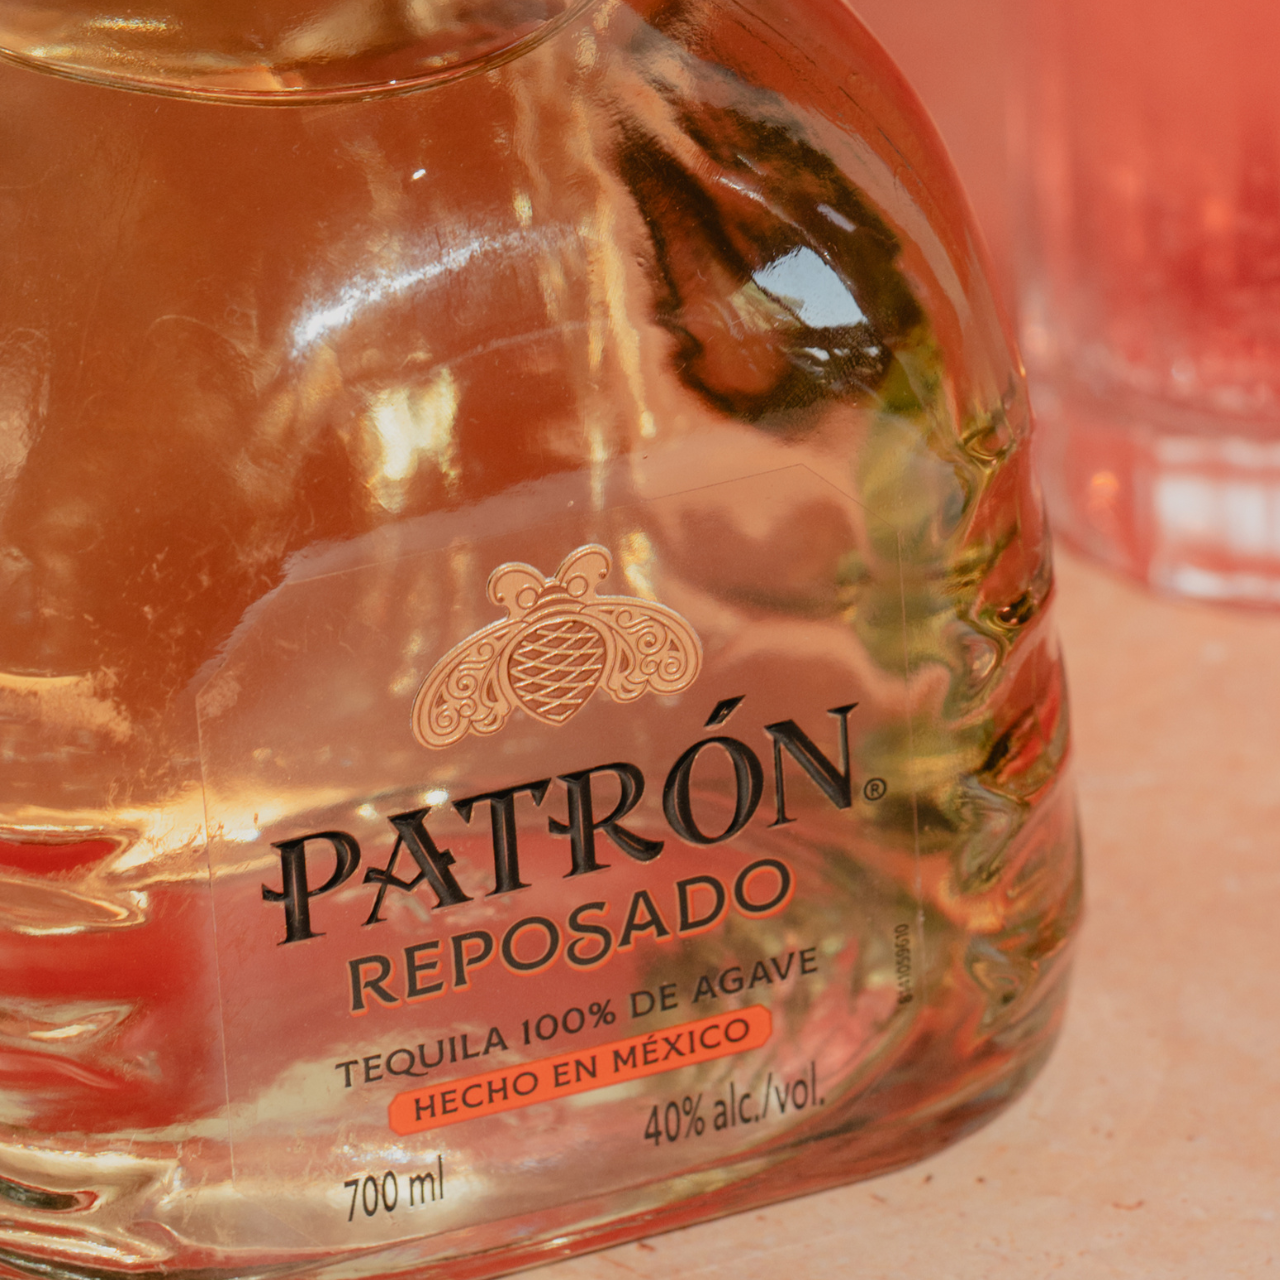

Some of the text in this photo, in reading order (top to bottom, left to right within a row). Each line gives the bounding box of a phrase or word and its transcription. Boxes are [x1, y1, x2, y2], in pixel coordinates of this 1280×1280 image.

[261, 694, 860, 946] PATRÓN
[348, 858, 796, 1017] REPOSADO
[334, 947, 819, 1089] TEQUILA 100% DE AGAVE
[413, 1018, 750, 1122] HECHO EN MÉXICO
[643, 1060, 826, 1147] 40% alc./vol.
[343, 1153, 444, 1223] 700 ml
